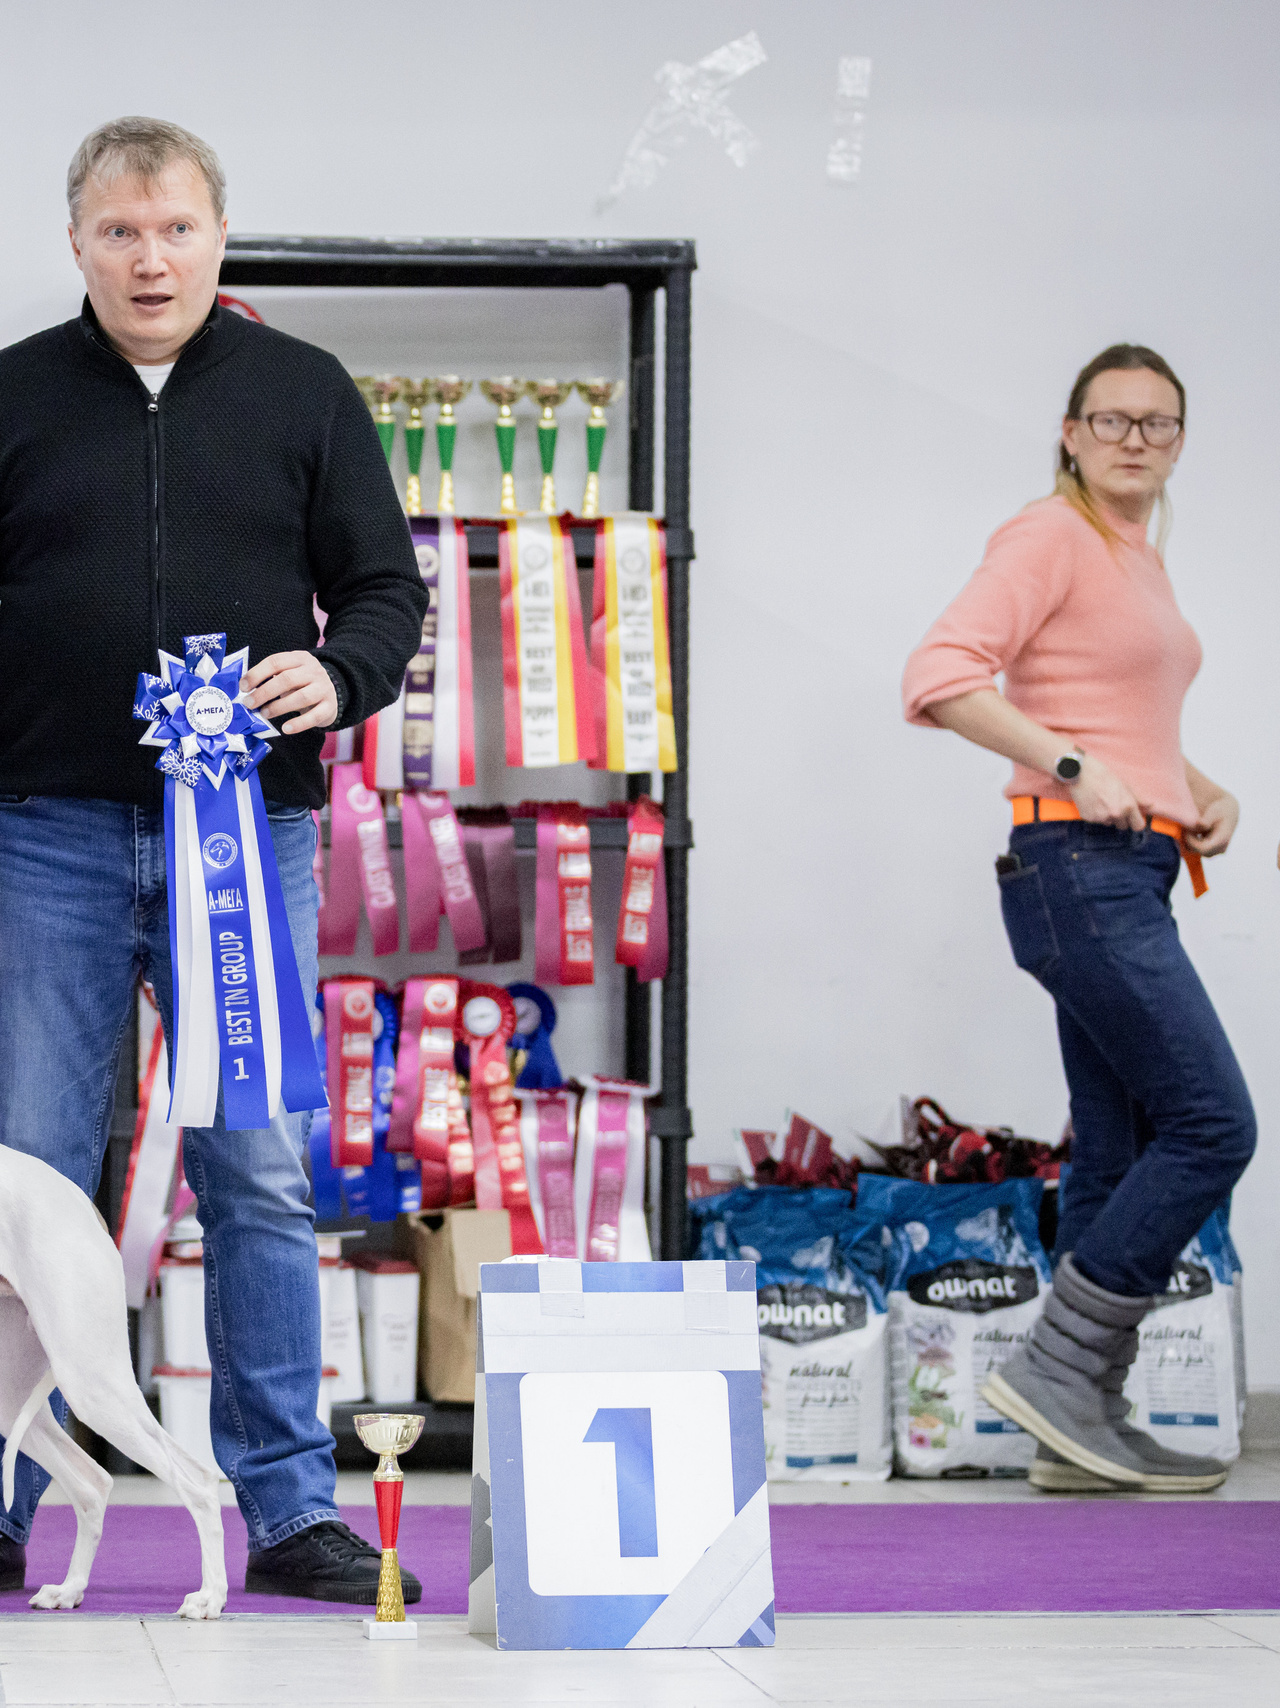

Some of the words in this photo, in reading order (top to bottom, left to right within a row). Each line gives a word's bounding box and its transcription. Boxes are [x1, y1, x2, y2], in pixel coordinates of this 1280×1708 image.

[219, 931, 248, 985] GROUP
[224, 987, 250, 1008] IN
[225, 1009, 253, 1047] BEST
[233, 1057, 250, 1081] 1
[927, 1275, 1017, 1302] ownat
[758, 1301, 846, 1326] ownat
[789, 1359, 853, 1379] natural
[582, 1407, 659, 1558] 1
